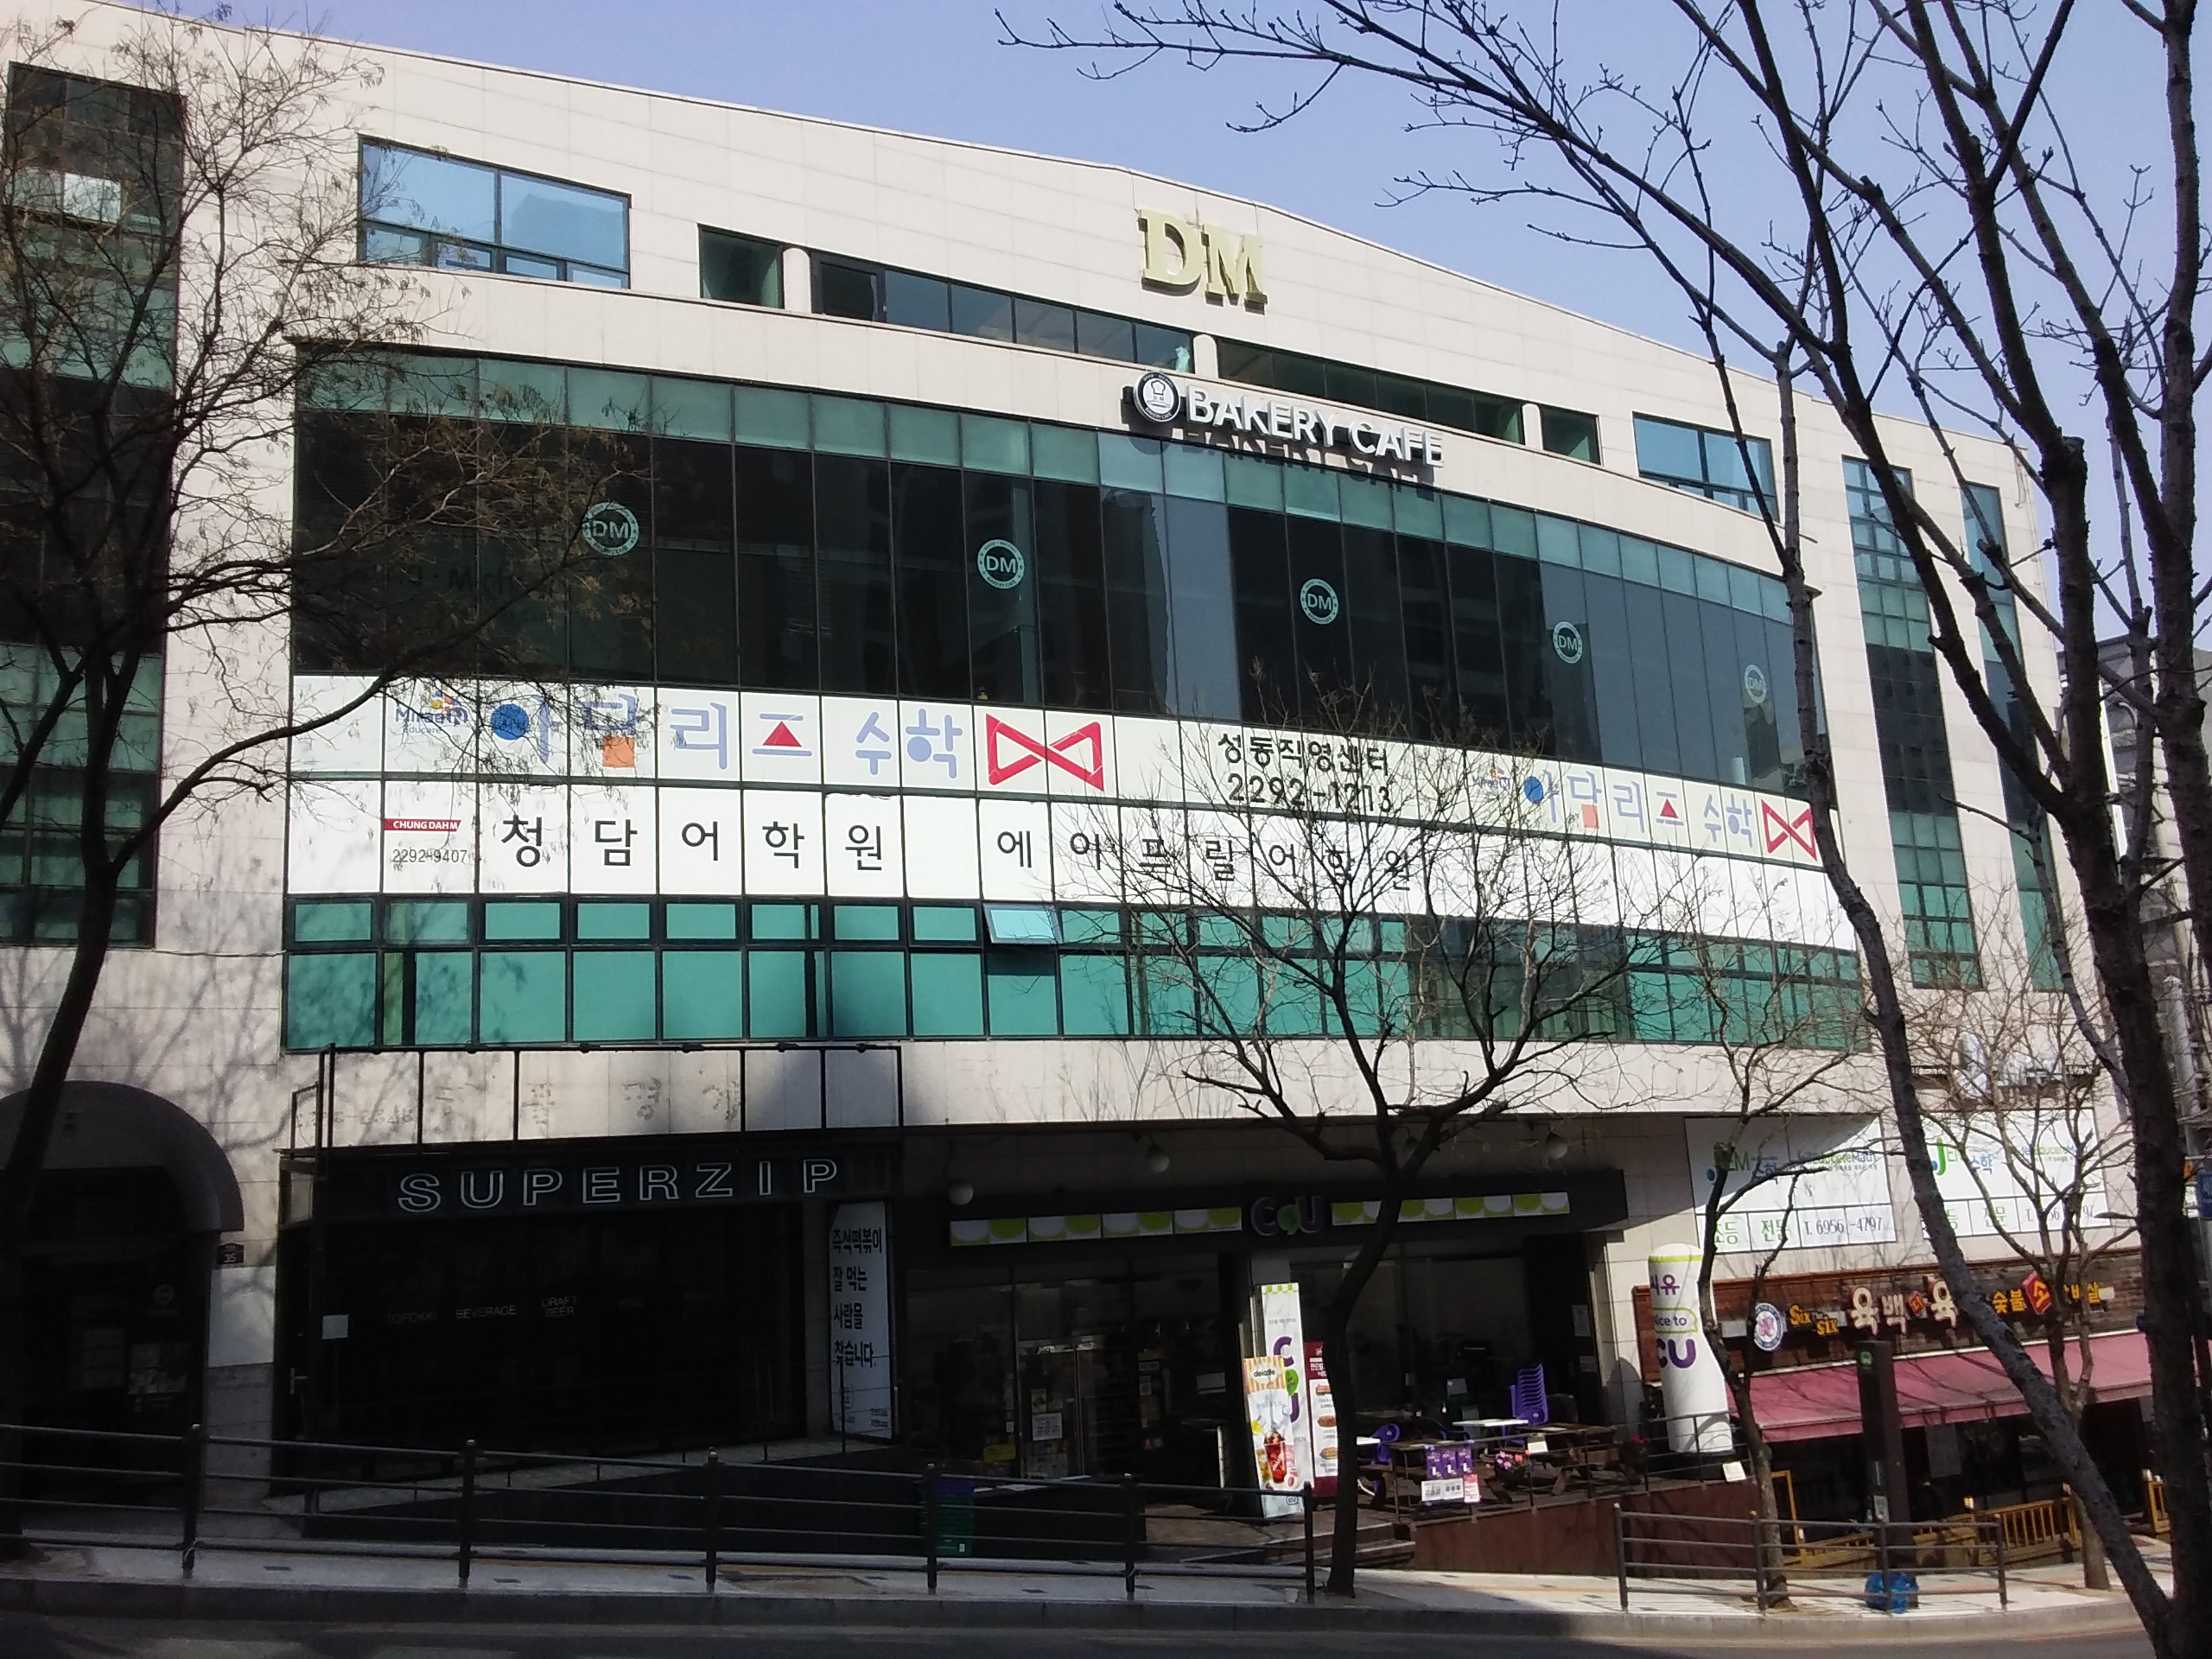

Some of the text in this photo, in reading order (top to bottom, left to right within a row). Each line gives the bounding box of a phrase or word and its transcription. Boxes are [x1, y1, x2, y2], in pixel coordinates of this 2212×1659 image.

[1138, 209, 1268, 313] DM
[1186, 385, 1445, 467] BAKERY CAFE
[591, 520, 629, 539] DM
[986, 555, 1016, 574] DM
[1307, 593, 1332, 611] DM
[1558, 634, 1578, 652] DM
[855, 708, 963, 779] 수학
[1217, 733, 1389, 777] 성동직영센터
[1703, 792, 1754, 849] 수학
[392, 849, 468, 863] 2292-9407
[500, 814, 883, 871] 청담어학원
[397, 1158, 837, 1213] SUPERZIP
[1249, 1196, 1325, 1237] CU
[455, 1305, 517, 1319] BEVERAGE
[834, 1302, 863, 1329] 사람을
[1674, 1315, 1688, 1326] to
